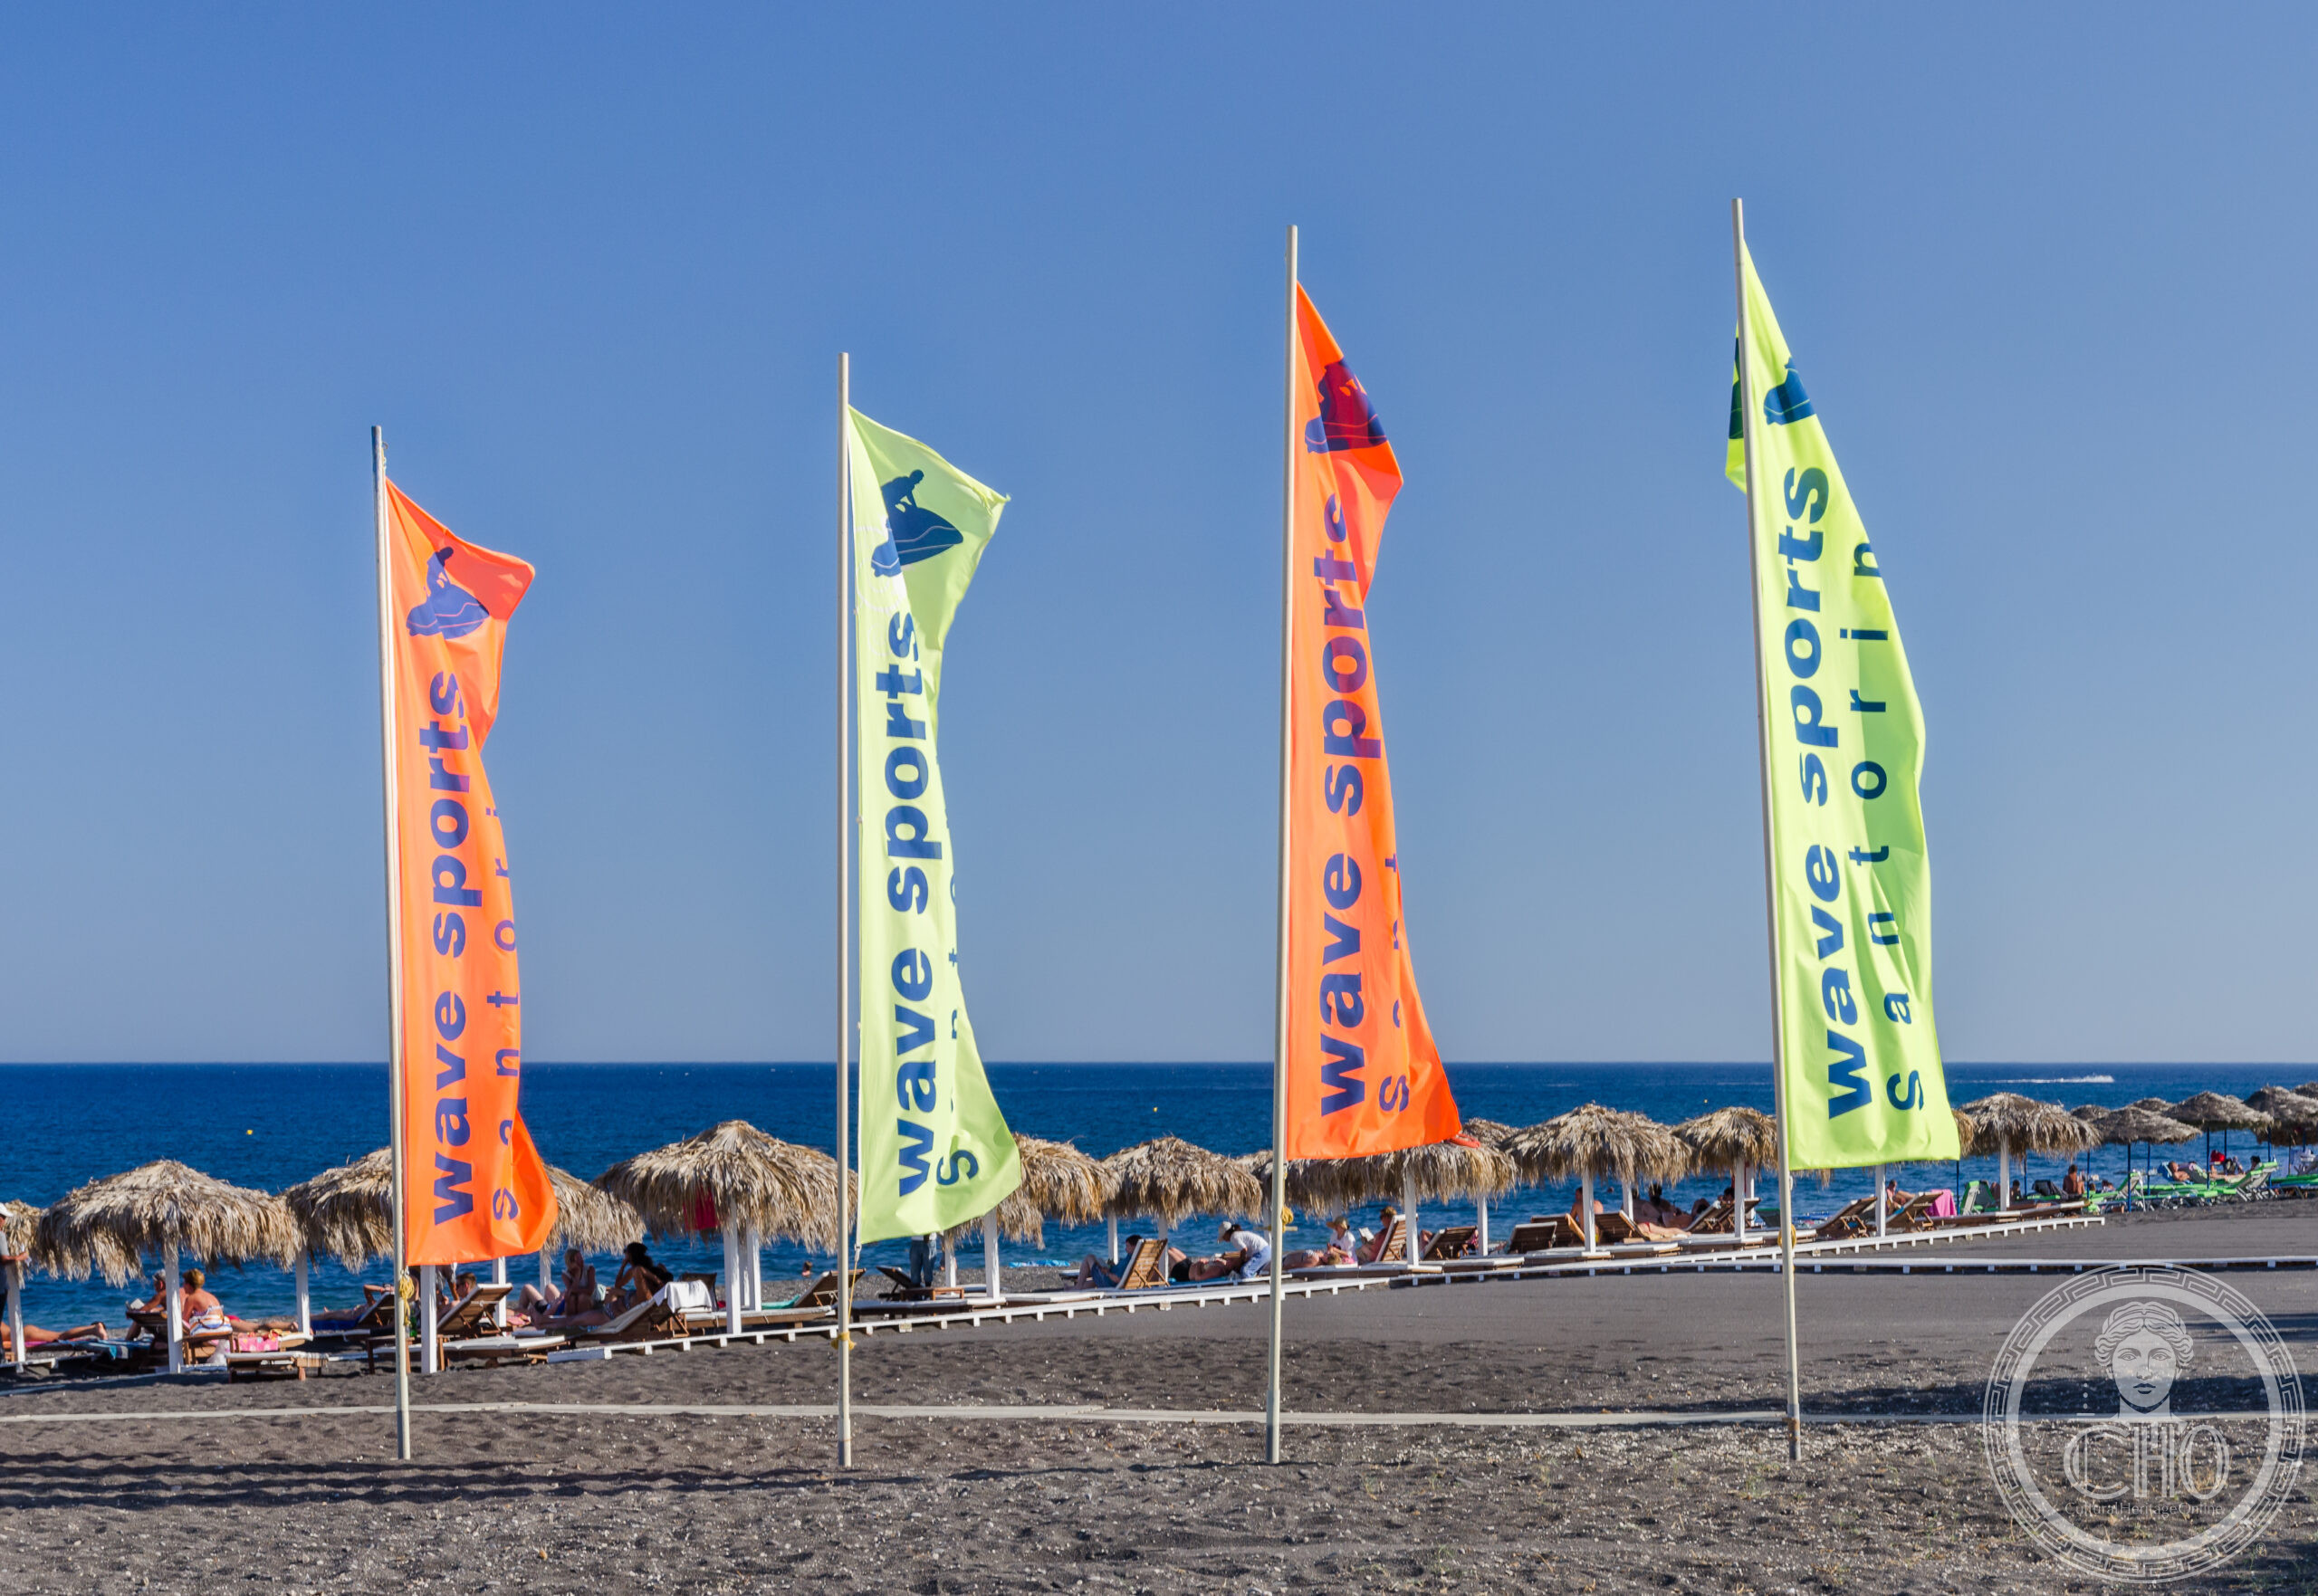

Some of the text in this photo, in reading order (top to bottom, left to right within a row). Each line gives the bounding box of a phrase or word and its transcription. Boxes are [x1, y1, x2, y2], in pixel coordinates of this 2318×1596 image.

[420, 672, 482, 1225] wave sports
[876, 612, 943, 1197] wave sports
[1320, 853, 1365, 1116] wave
[1777, 468, 1873, 1120] wave sports
